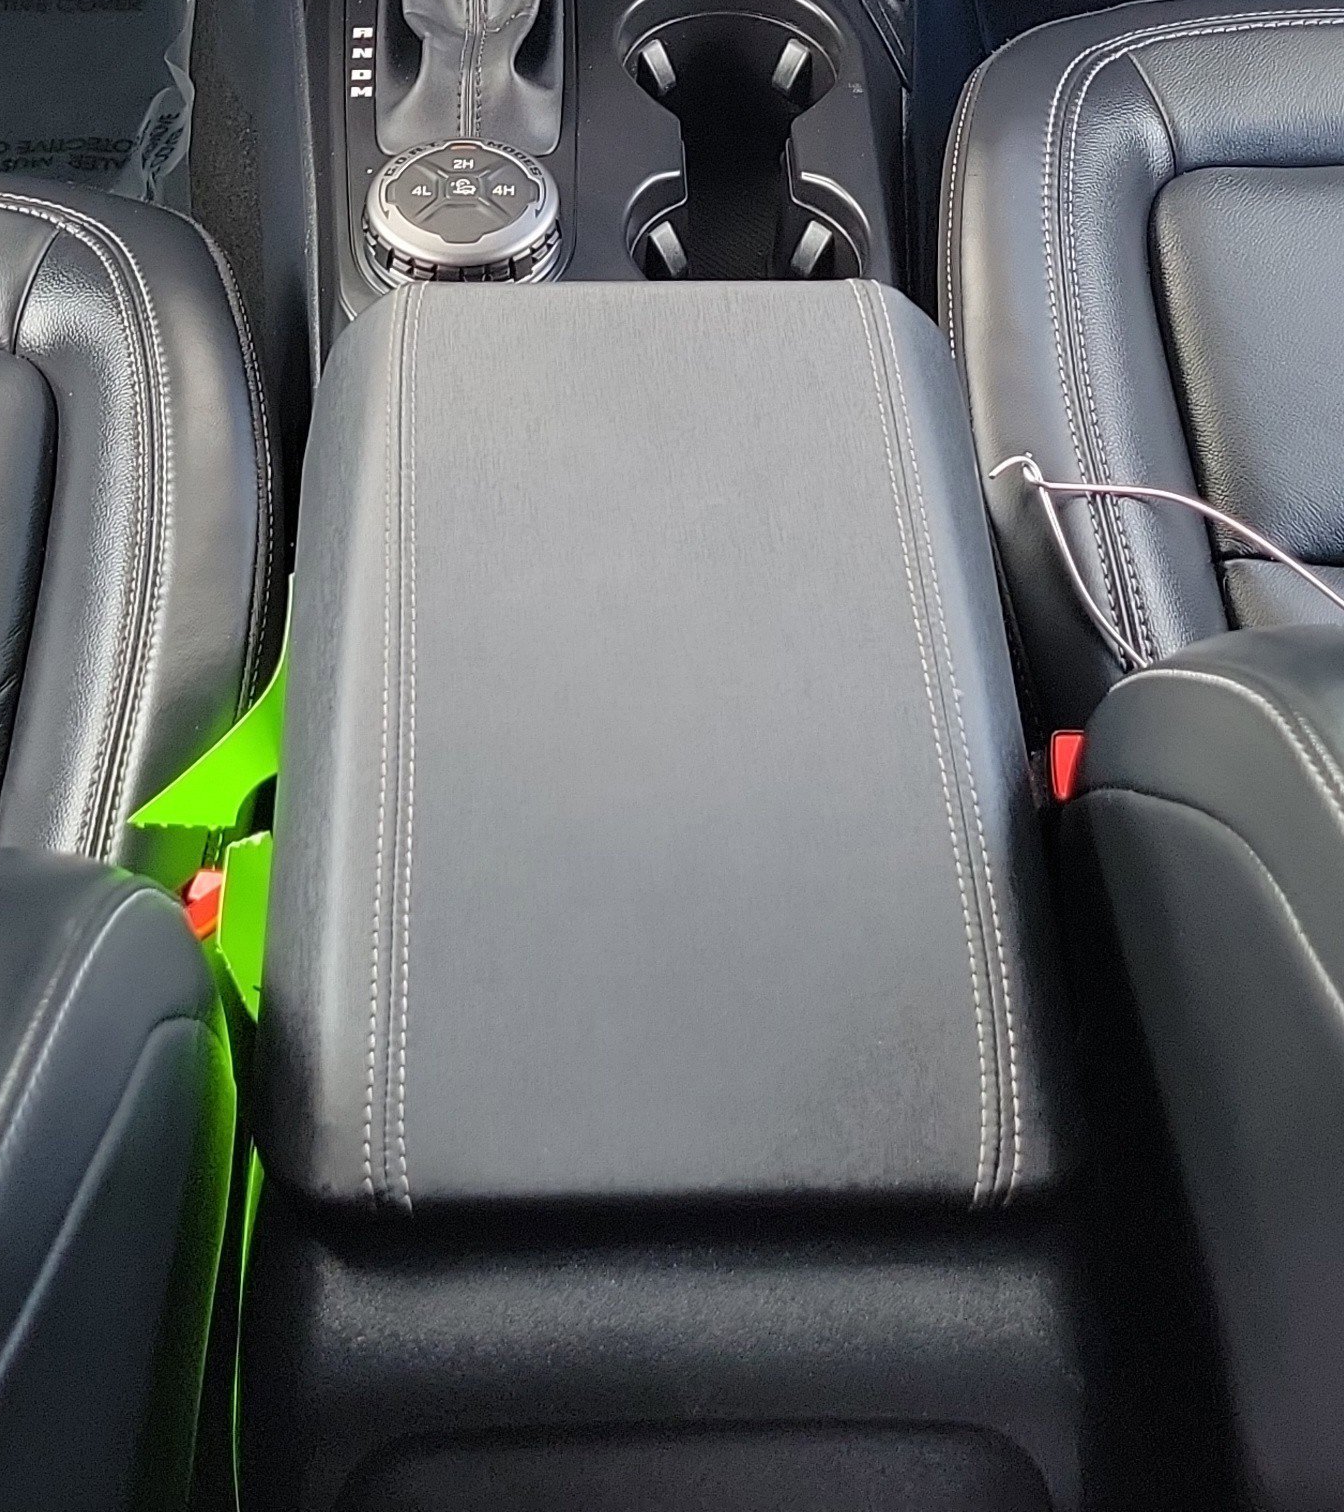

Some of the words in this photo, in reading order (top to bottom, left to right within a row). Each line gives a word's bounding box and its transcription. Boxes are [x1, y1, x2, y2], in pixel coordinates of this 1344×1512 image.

[351, 47, 373, 59] N
[350, 86, 373, 98] M
[18, 136, 135, 155] OTECTIVE
[68, 153, 131, 172] ALER
[453, 159, 475, 170] 2H
[486, 141, 544, 177] MODES
[411, 185, 432, 196] 4L
[492, 185, 515, 196] 4H
